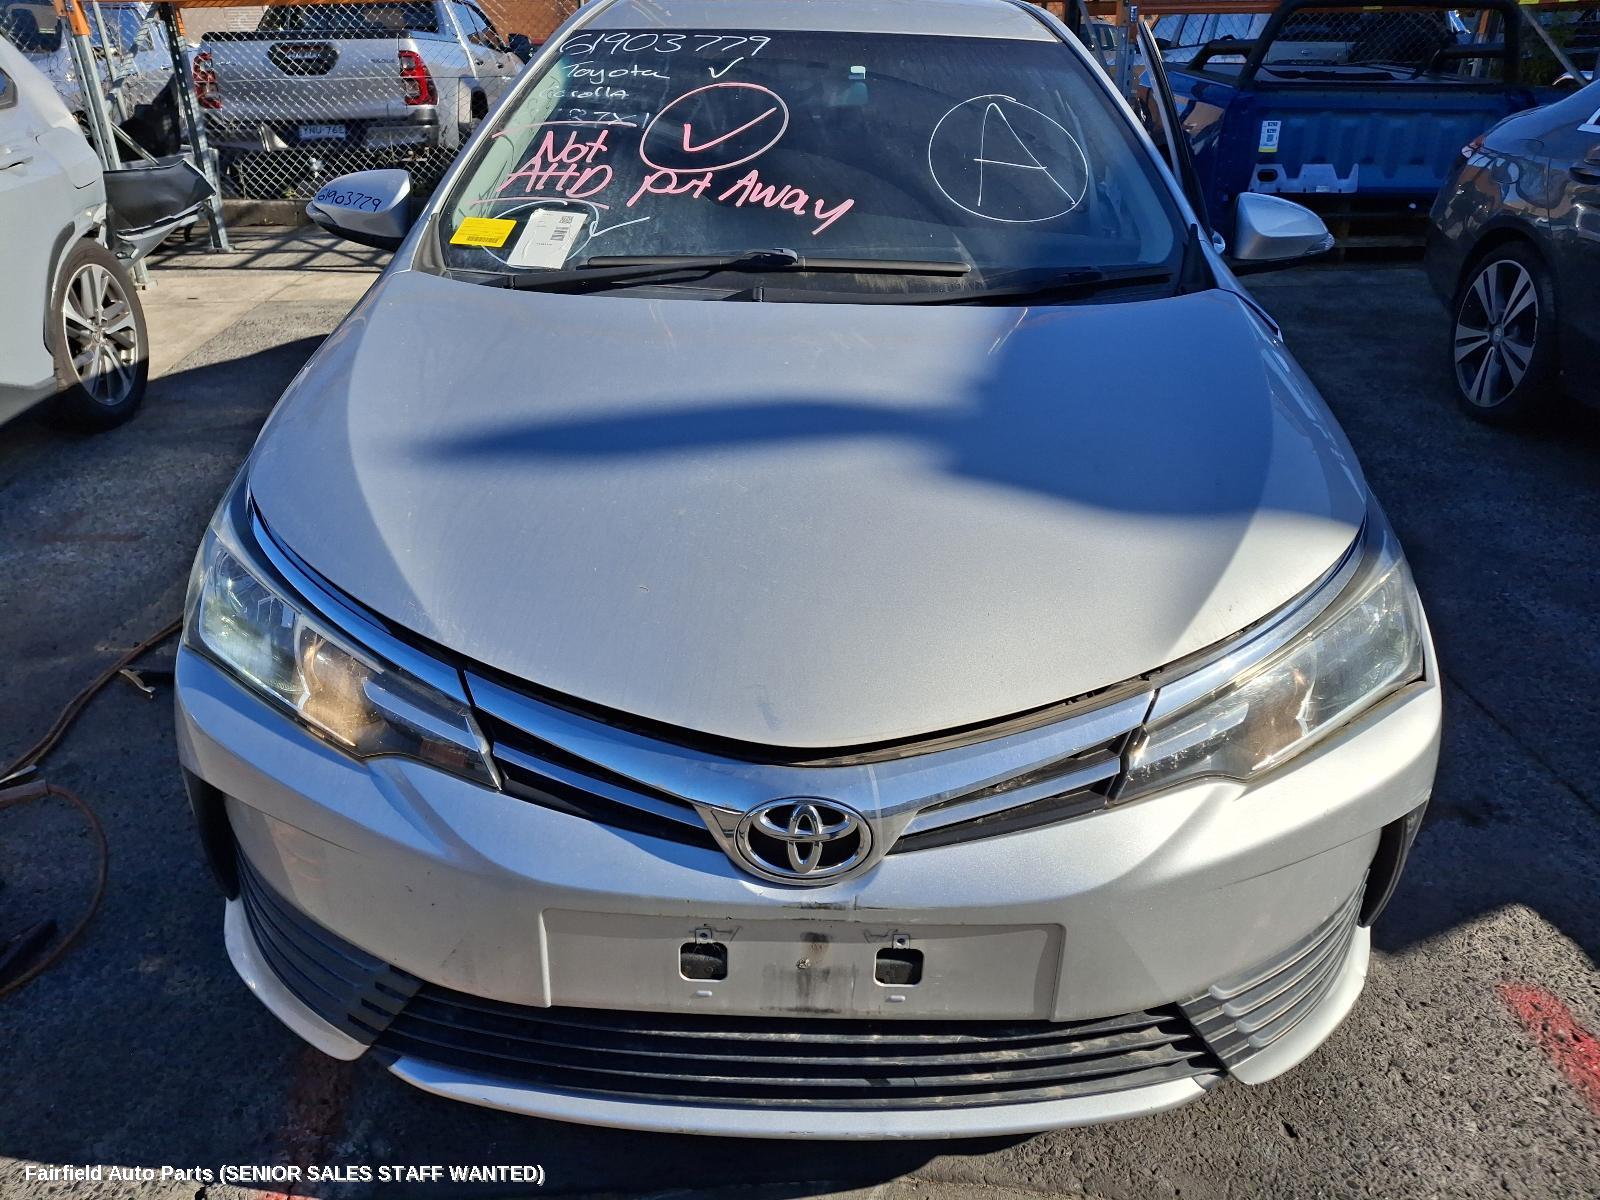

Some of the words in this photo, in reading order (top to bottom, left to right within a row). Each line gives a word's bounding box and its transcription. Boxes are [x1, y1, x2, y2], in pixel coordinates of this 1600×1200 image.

[560, 32, 771, 56] 61903779
[561, 60, 671, 84] Toyota
[535, 130, 609, 163] Not
[973, 102, 1076, 207] A
[718, 169, 855, 235] Away
